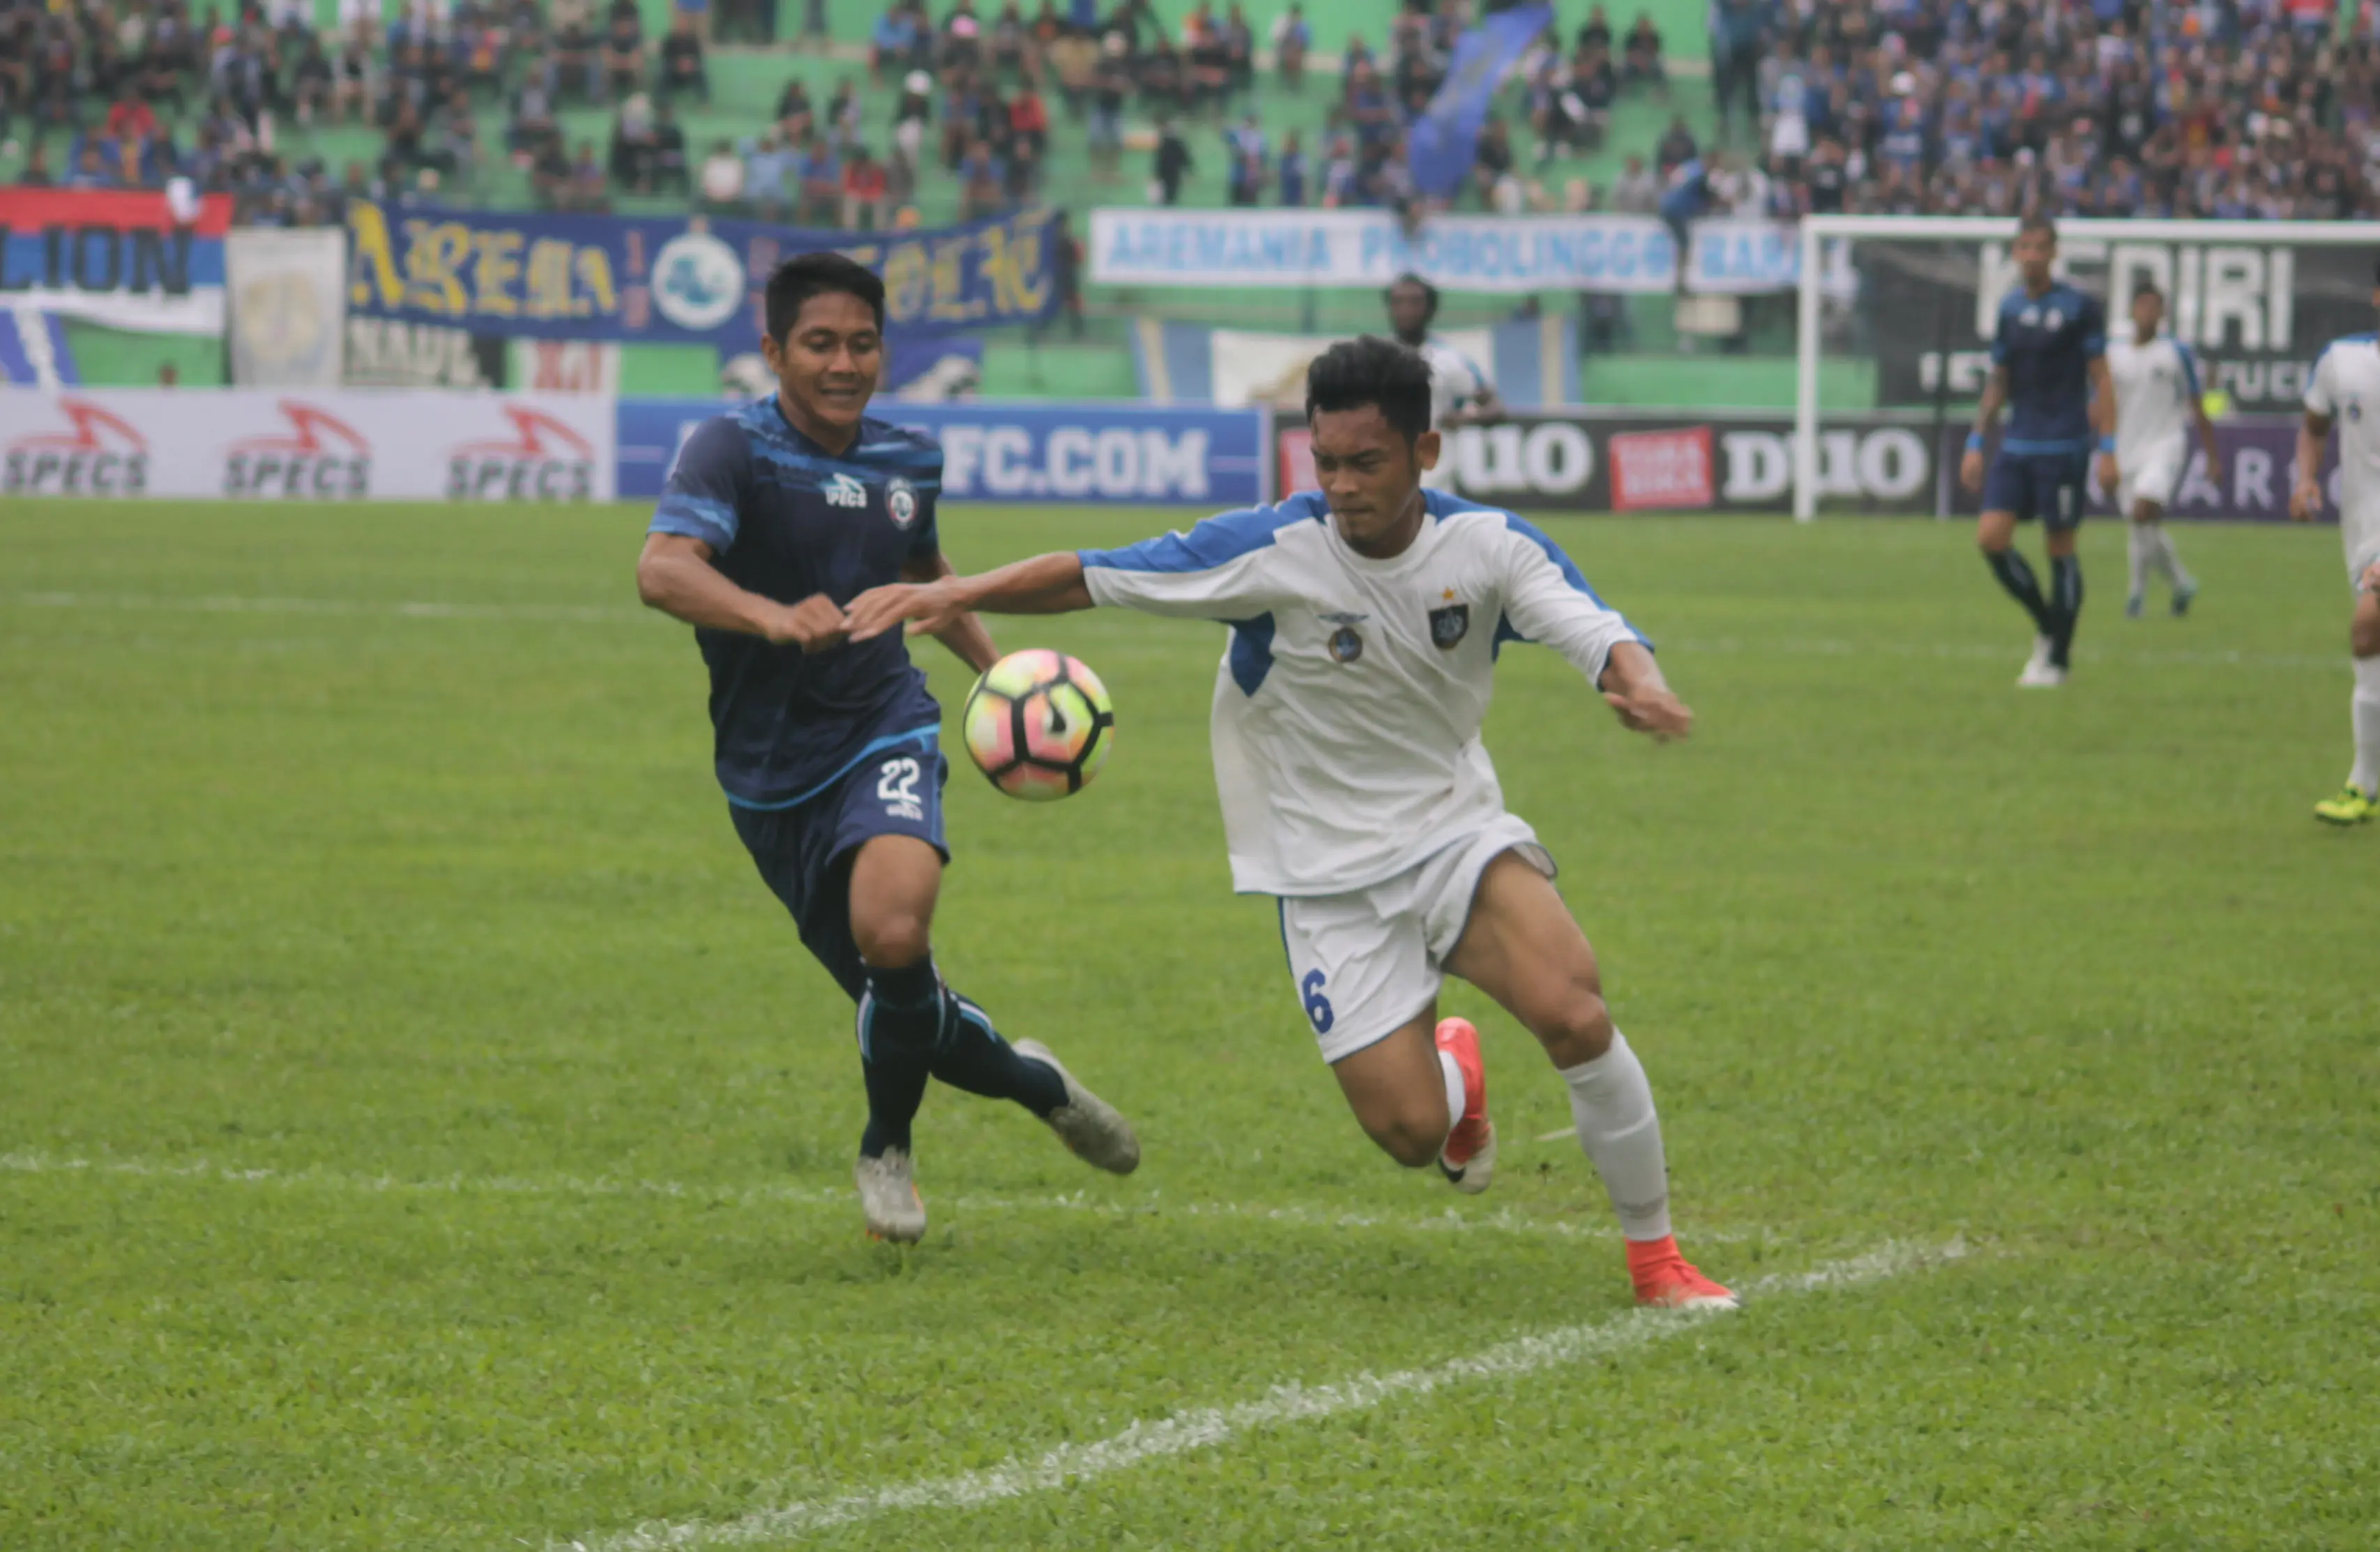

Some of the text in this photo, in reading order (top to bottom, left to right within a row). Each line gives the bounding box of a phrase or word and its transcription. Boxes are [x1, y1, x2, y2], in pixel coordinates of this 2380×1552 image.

[4, 453, 148, 491] SPECS
[225, 456, 370, 495] SPECS
[446, 459, 594, 499] SPECS
[877, 757, 922, 805] 22
[1302, 968, 1335, 1034] 6
